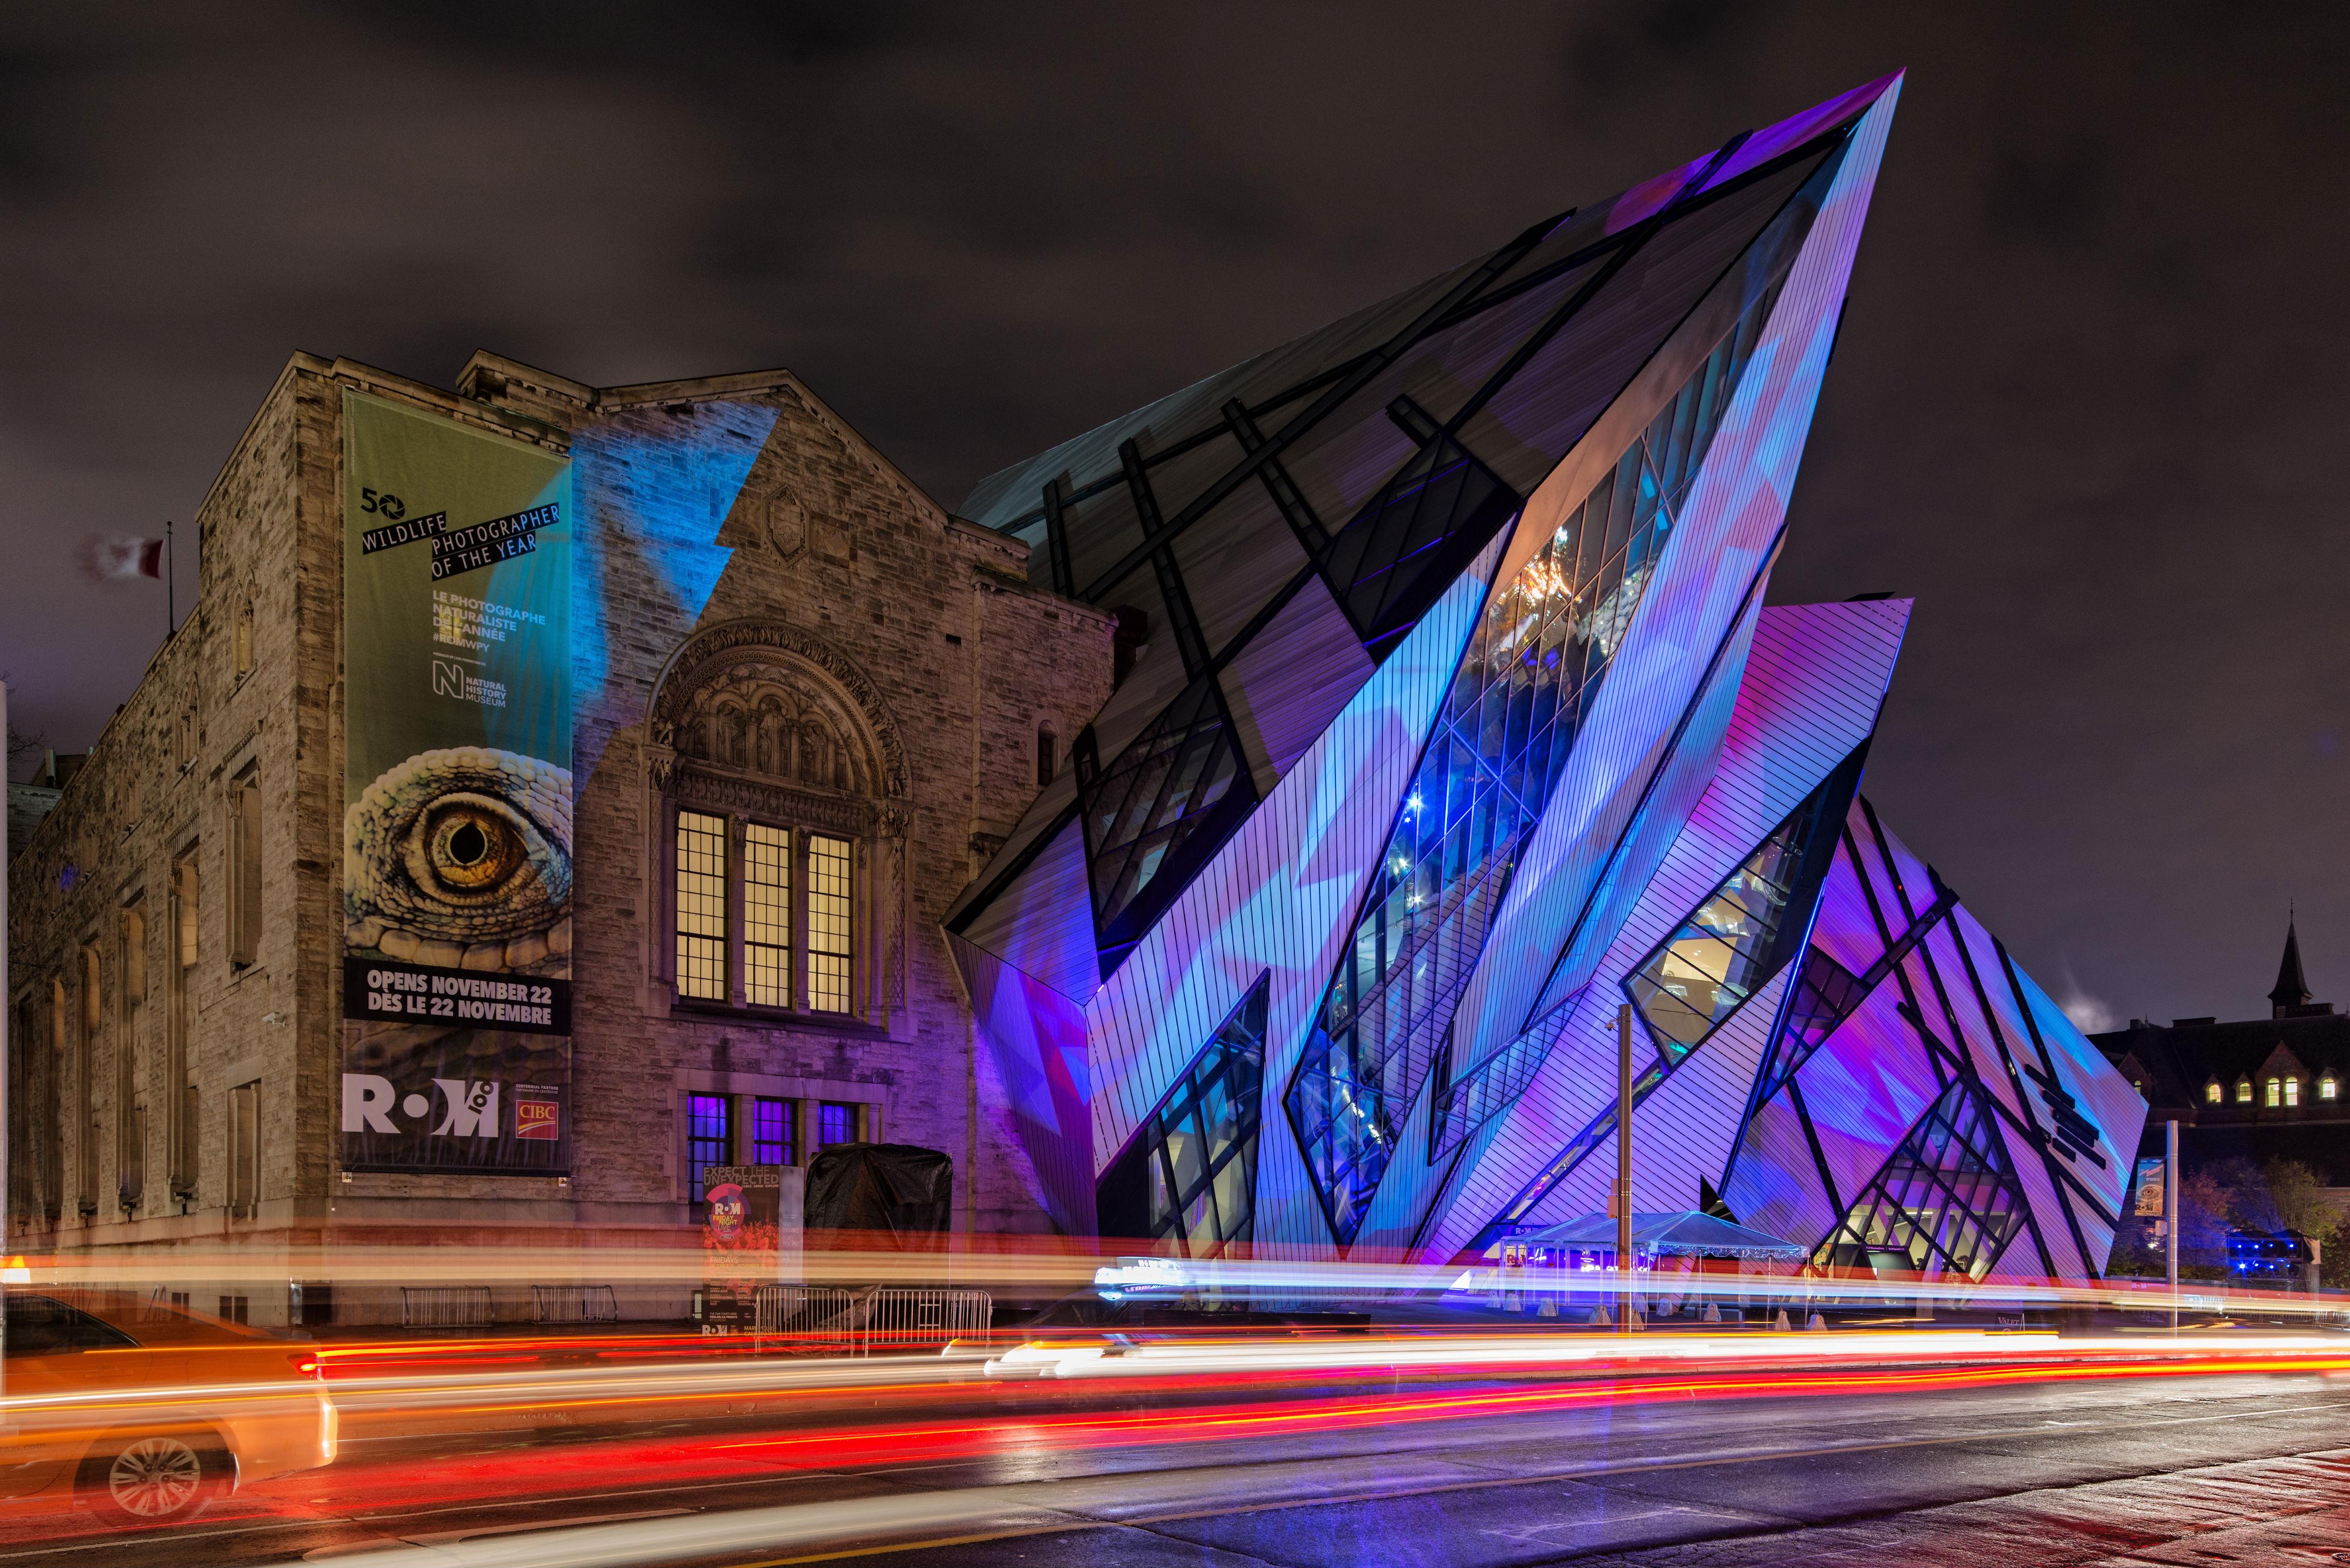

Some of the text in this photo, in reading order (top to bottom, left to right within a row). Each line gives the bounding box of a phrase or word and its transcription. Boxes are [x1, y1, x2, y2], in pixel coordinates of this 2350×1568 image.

[362, 515, 446, 550] WILDLIFE
[432, 505, 559, 555] PHOTOGRAPHER
[431, 533, 536, 577] OF THE YEAR
[433, 590, 546, 626] LE PHOTOGRAPHE
[433, 603, 517, 632] NATURALISTE
[433, 616, 506, 642] DE L'ANNÉE
[433, 632, 490, 652] #ROMWPY
[465, 676, 506, 692] NATURAL
[465, 684, 507, 700] HISTORY
[465, 693, 506, 708] MUSEUM
[367, 969, 552, 1005] OPENS NOVEMBER 22
[368, 988, 552, 1025] DÈS LE 22 NOVEMBRE
[519, 1104, 555, 1120] CIBC
[704, 1166, 770, 1176] EXPECT THE
[704, 1174, 779, 1186] UNEXPECTED
[1998, 1317, 2020, 1326] VALET
